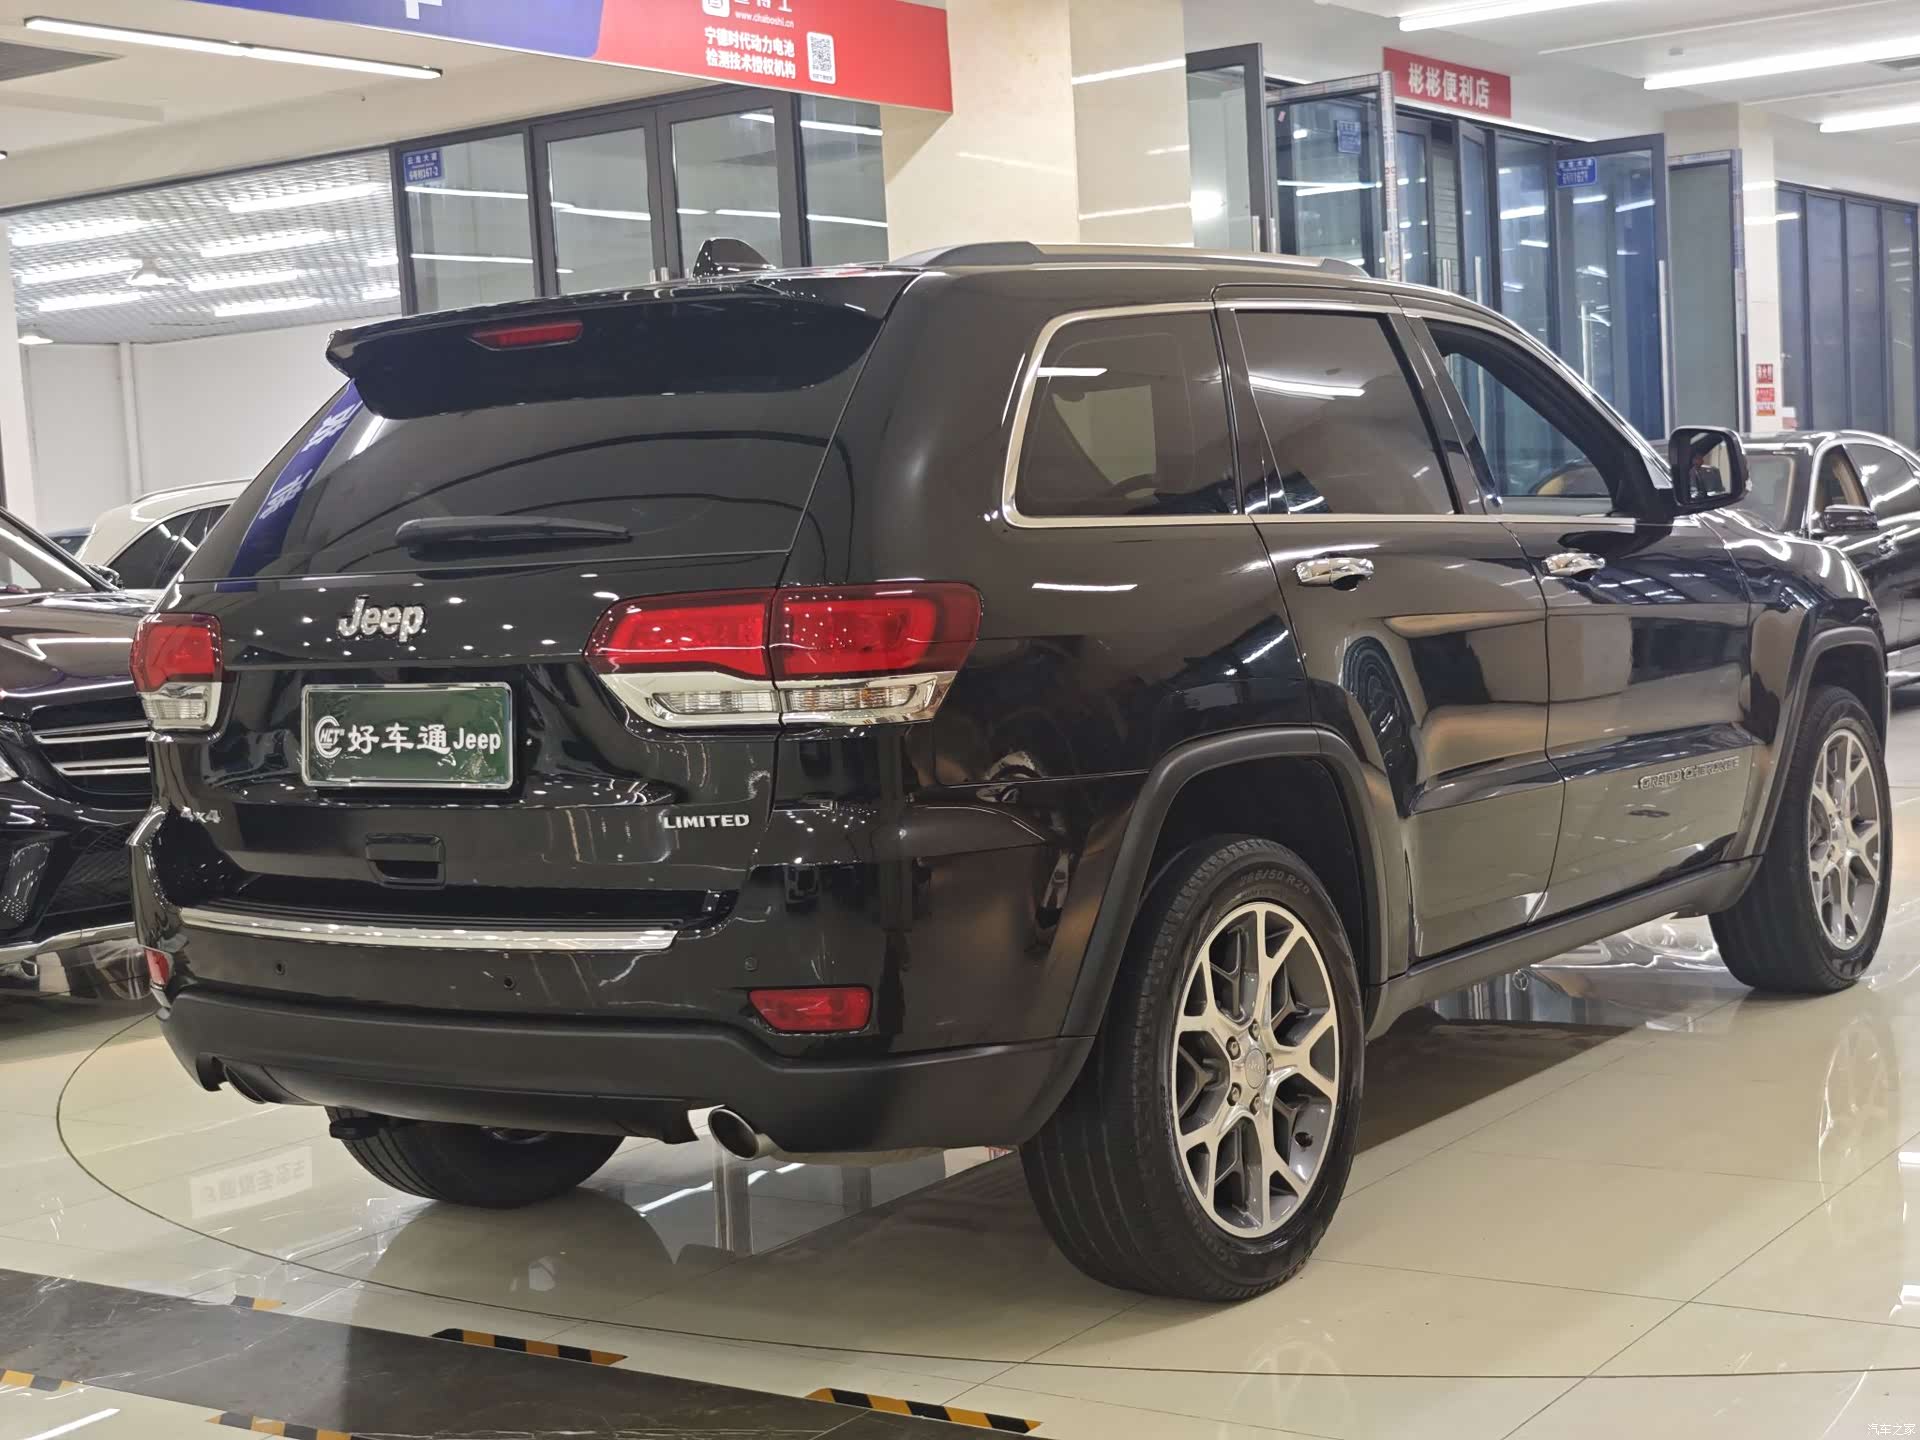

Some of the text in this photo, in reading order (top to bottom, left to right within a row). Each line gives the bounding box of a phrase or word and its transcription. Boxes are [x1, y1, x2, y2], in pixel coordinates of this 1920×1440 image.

[735, 11, 795, 28] www.chaboshi.cn
[704, 26, 796, 58] 宁德时代动力电池
[705, 47, 797, 80] 检测技术授权机构
[1408, 62, 1490, 109] 彬彬便利店
[338, 597, 425, 643] Jeep
[663, 813, 751, 829] LIMITED
